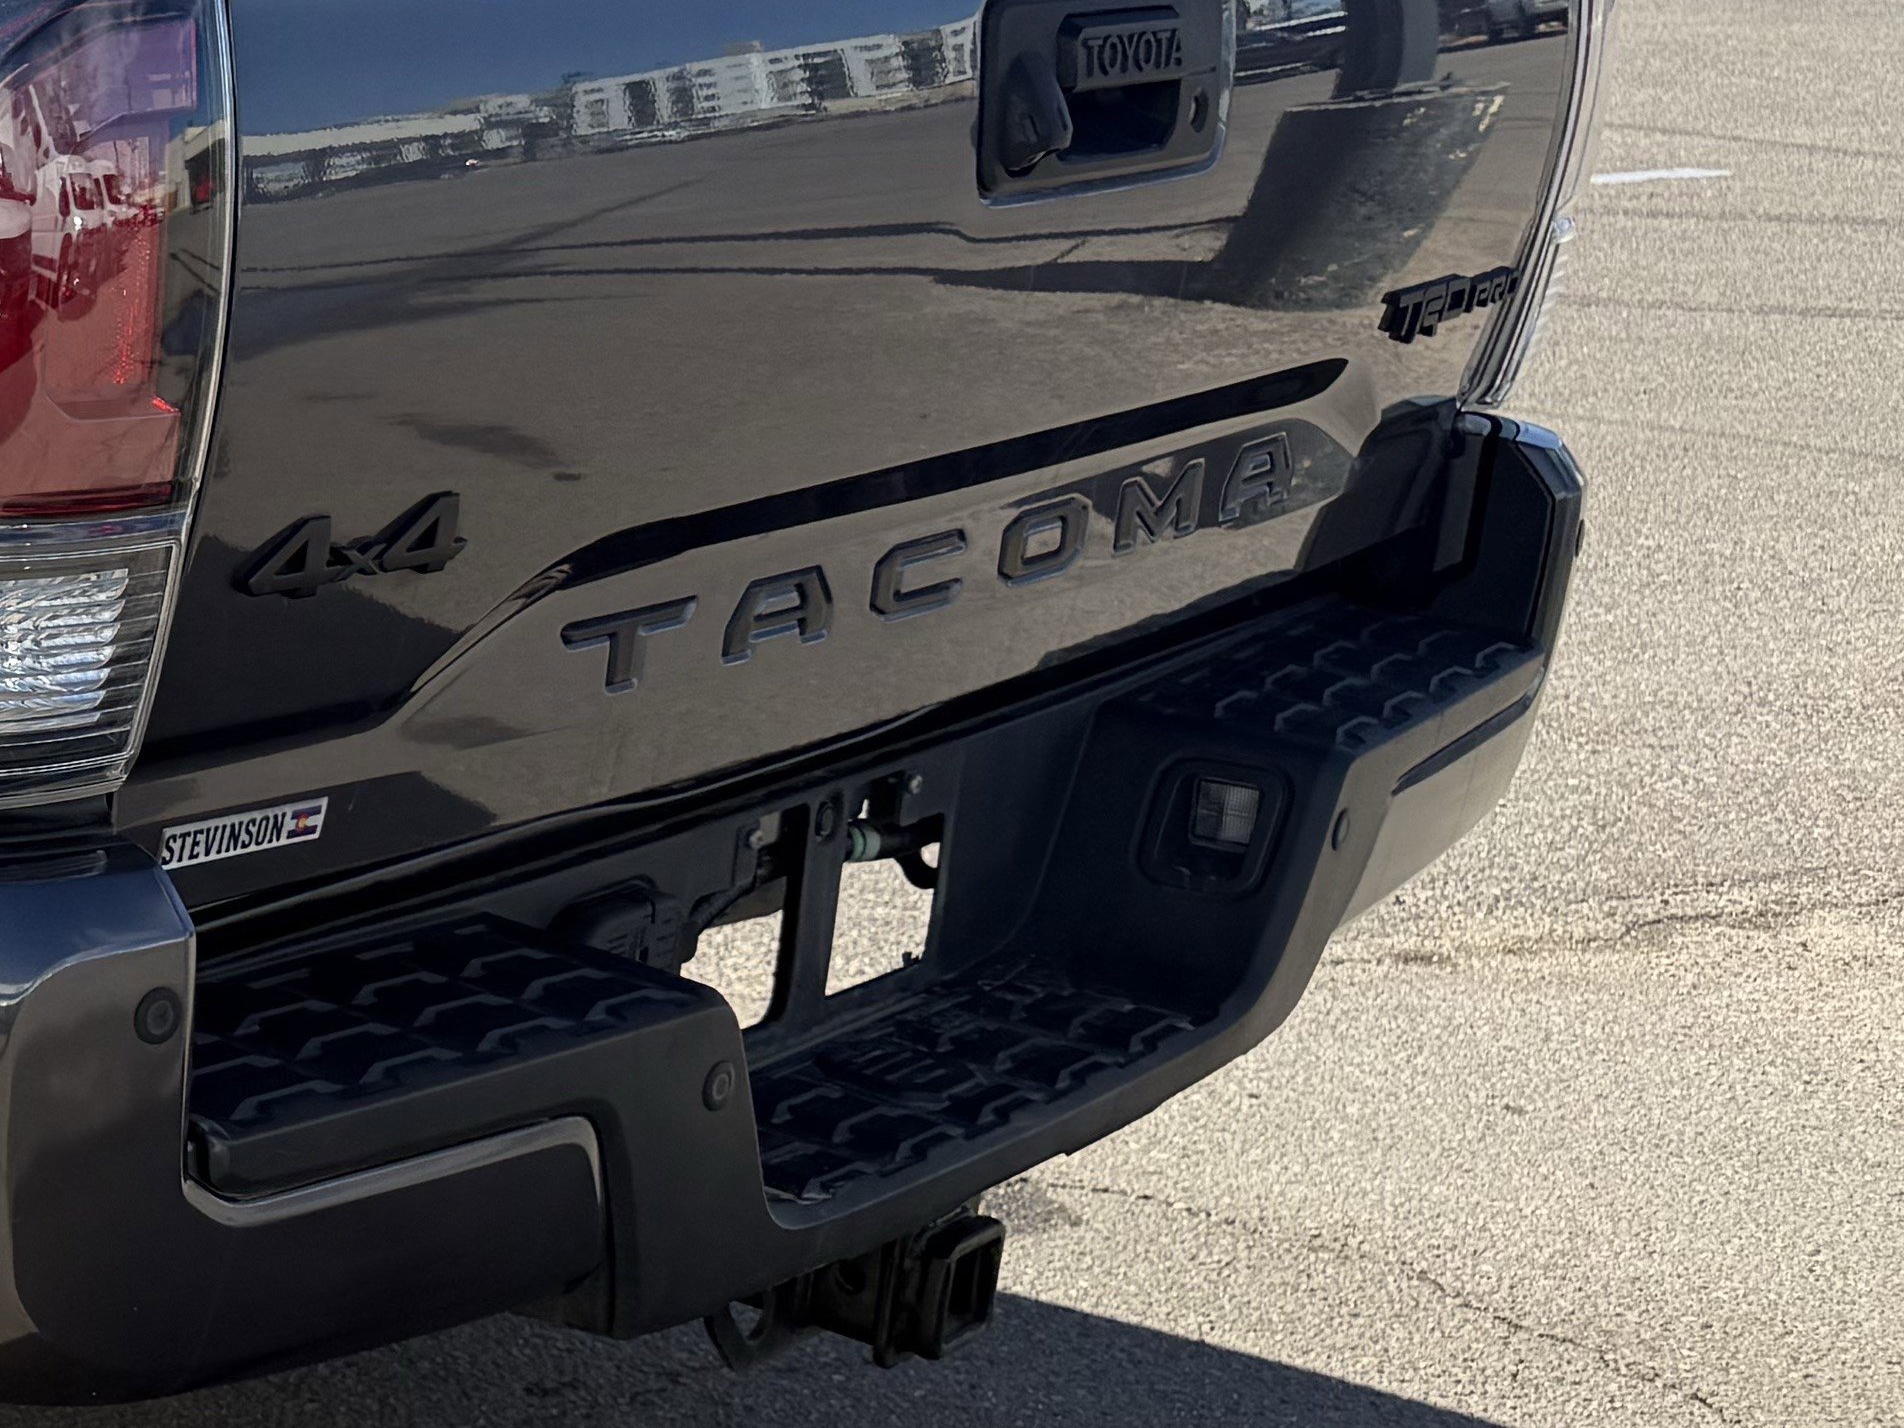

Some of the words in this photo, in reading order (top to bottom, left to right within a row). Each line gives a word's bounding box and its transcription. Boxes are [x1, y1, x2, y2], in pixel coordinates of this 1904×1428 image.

[1081, 28, 1183, 78] TOYOTA
[559, 431, 1295, 694] TACOMA
[161, 811, 287, 865] STEVINSON
